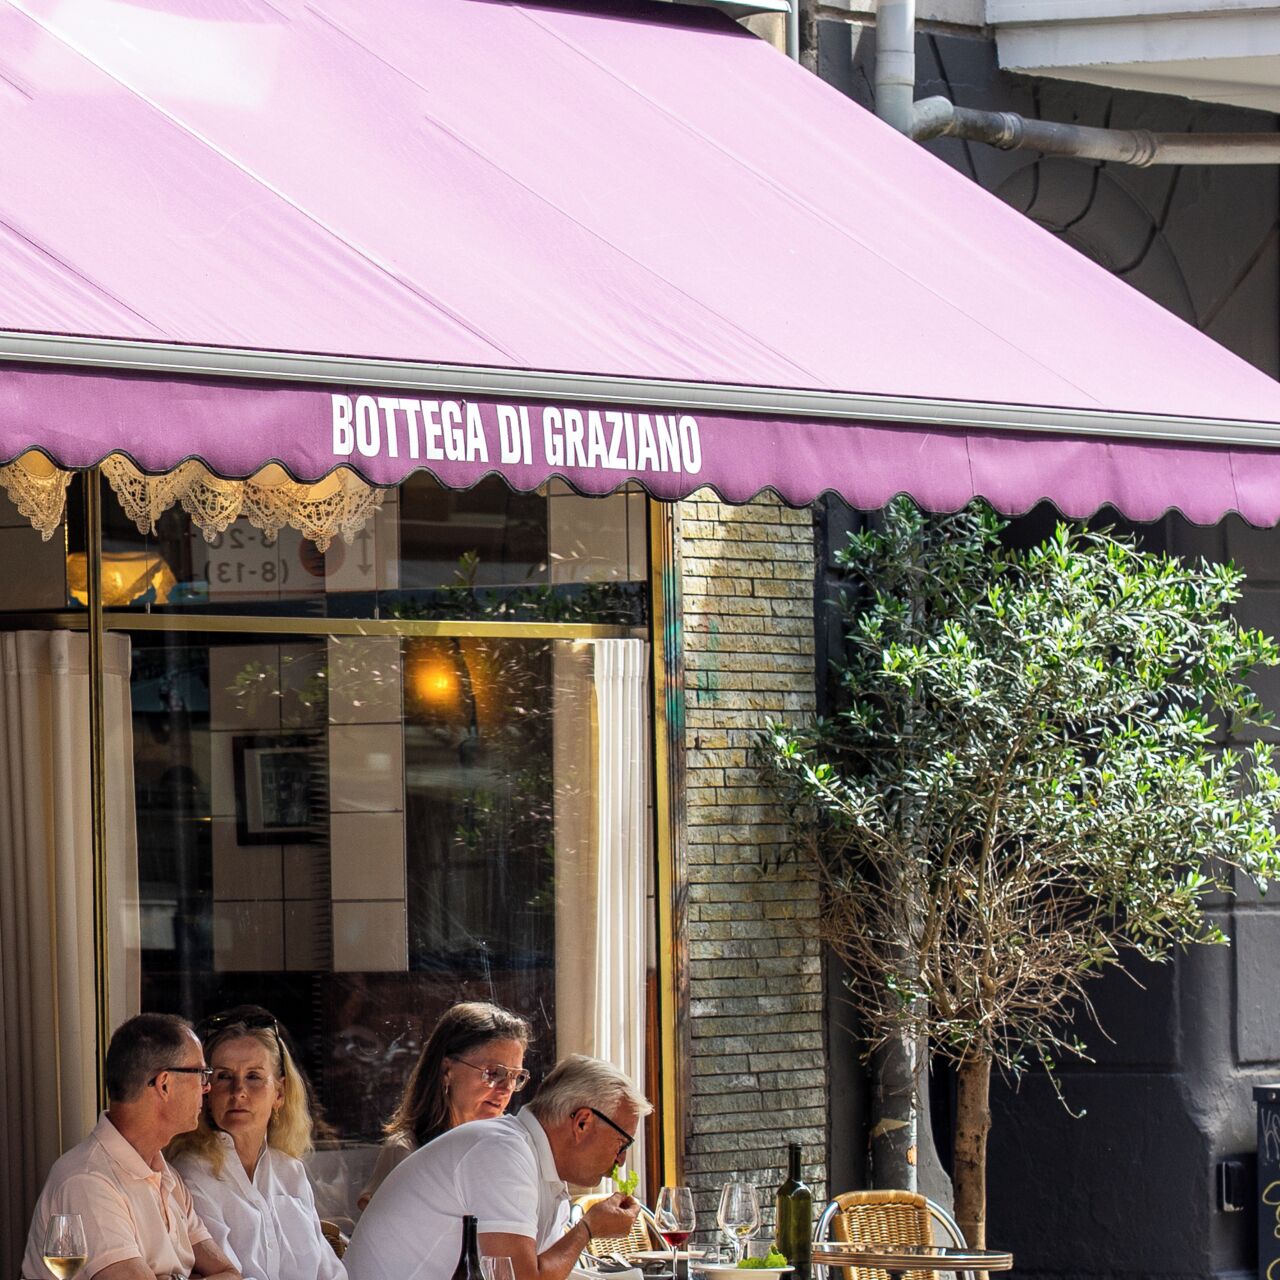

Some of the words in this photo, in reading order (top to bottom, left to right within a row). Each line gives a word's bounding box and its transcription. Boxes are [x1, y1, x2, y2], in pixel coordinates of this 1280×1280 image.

[332, 393, 489, 463] BOTTEGA
[497, 404, 533, 465] DI
[542, 406, 702, 474] GRAZIANO
